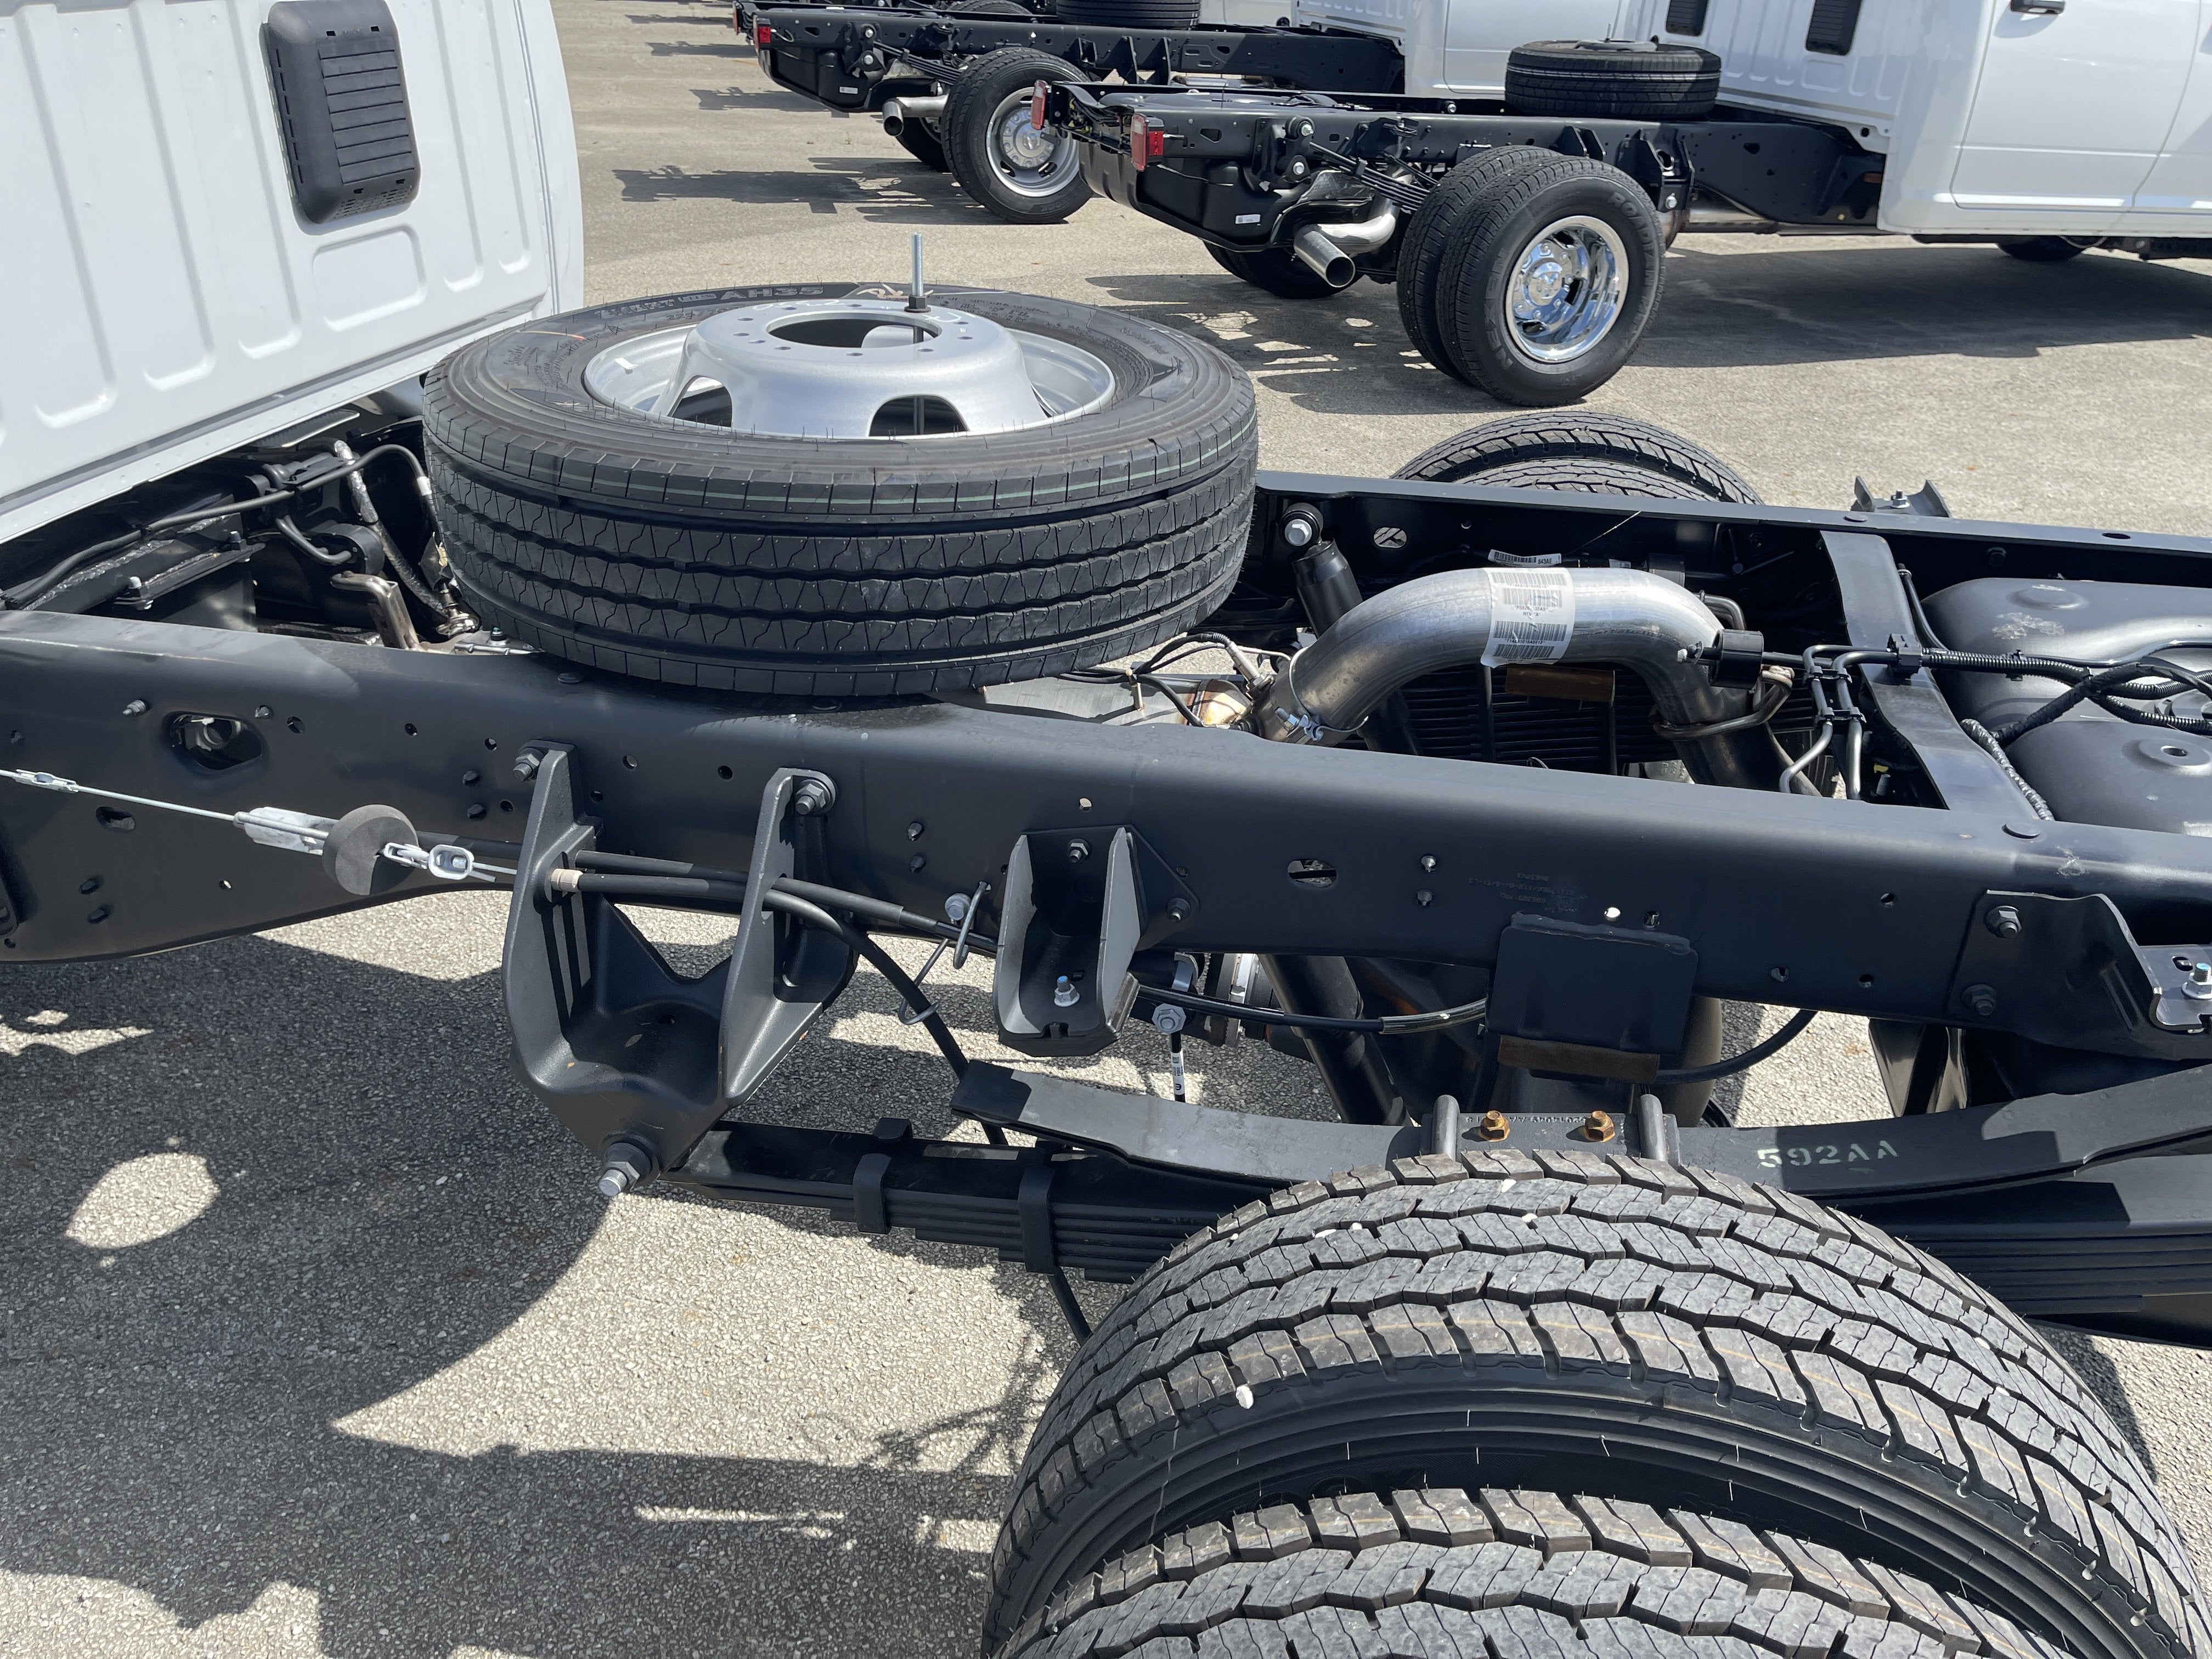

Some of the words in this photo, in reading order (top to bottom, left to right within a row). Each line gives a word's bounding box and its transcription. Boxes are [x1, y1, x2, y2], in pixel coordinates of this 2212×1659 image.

[720, 286, 824, 300] AH35
[1484, 247, 1514, 367] NEXEN
[1756, 1140, 1899, 1168] 592AA
